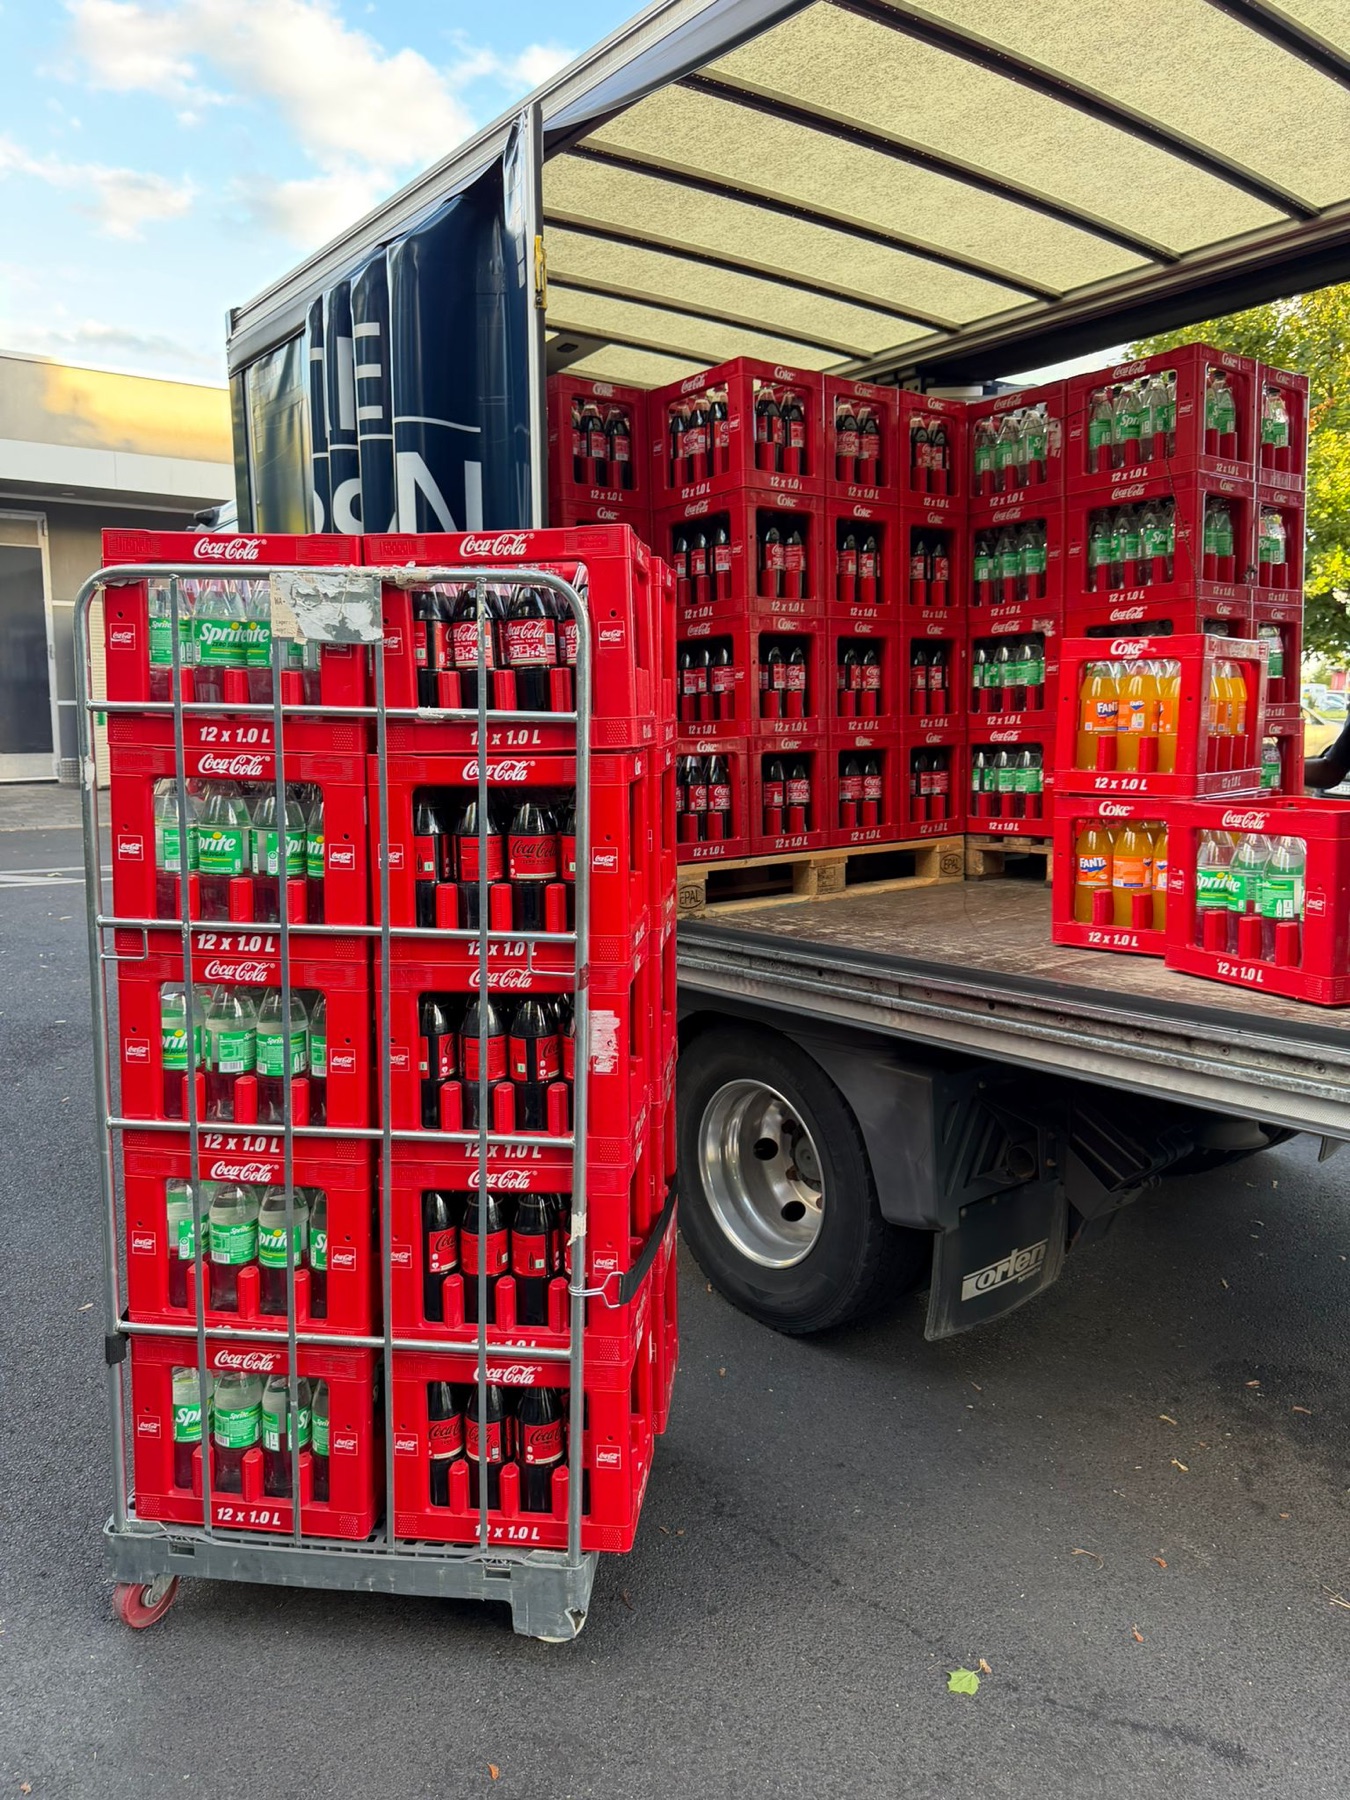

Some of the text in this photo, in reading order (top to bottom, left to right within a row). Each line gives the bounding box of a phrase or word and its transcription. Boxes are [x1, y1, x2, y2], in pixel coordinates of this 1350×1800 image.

[1112, 467, 1148, 482] 12 x 1.0 L
[591, 490, 599, 498] 12
[606, 492, 616, 500] 1.0
[681, 489, 690, 498] 12
[696, 484, 705, 496] 1.0
[194, 538, 262, 560] Coca-Cola
[460, 534, 530, 557] Coca-Cola
[1109, 593, 1117, 602] 12
[1126, 592, 1138, 600] 1.0
[684, 610, 692, 619] 12
[699, 608, 708, 617] 1.0
[770, 602, 779, 610] 12
[788, 602, 798, 612] 1.0
[1110, 640, 1143, 655] Coke
[774, 722, 783, 732] 12
[791, 722, 801, 731] 1.0
[987, 717, 996, 725] 12
[1004, 716, 1014, 724] 1.0
[200, 727, 270, 743] 12 x 1.0 L
[470, 729, 541, 745] 1 x 1.0 L
[688, 725, 696, 734] 12
[702, 725, 711, 734] 1.0
[198, 753, 265, 776] Coca-Cola
[1095, 778, 1148, 790] 12 x 1.0 L
[1099, 801, 1131, 816] Coke
[989, 822, 997, 830] 12
[1004, 822, 1012, 830] 1.0
[1222, 810, 1268, 829] Coca-Cola
[200, 836, 236, 851] prite
[775, 839, 784, 848] 12
[791, 838, 802, 846] 1.0
[693, 848, 702, 856] 12
[708, 846, 719, 854] 1.0
[679, 889, 702, 904] EPAL
[197, 934, 275, 951] 12 x 1.0 L
[1088, 932, 1138, 946] 12 x 1.0 L
[490, 945, 498, 956] x
[504, 942, 524, 956] 1.0
[205, 960, 268, 982] Coca-Cola
[1217, 962, 1263, 982] 12 x 1.0 L
[204, 1134, 280, 1152] 12 x 1.0 L
[487, 1146, 496, 1158] x
[504, 1144, 527, 1158] 1.0
[532, 1146, 541, 1158] L
[211, 1161, 273, 1182] Coca-Cola
[214, 1350, 274, 1370] Coca-Cola
[218, 1508, 281, 1525] 12 x 1.0 L
[494, 1527, 504, 1538] x
[508, 1526, 528, 1539] 1.0
[532, 1527, 540, 1540] L
